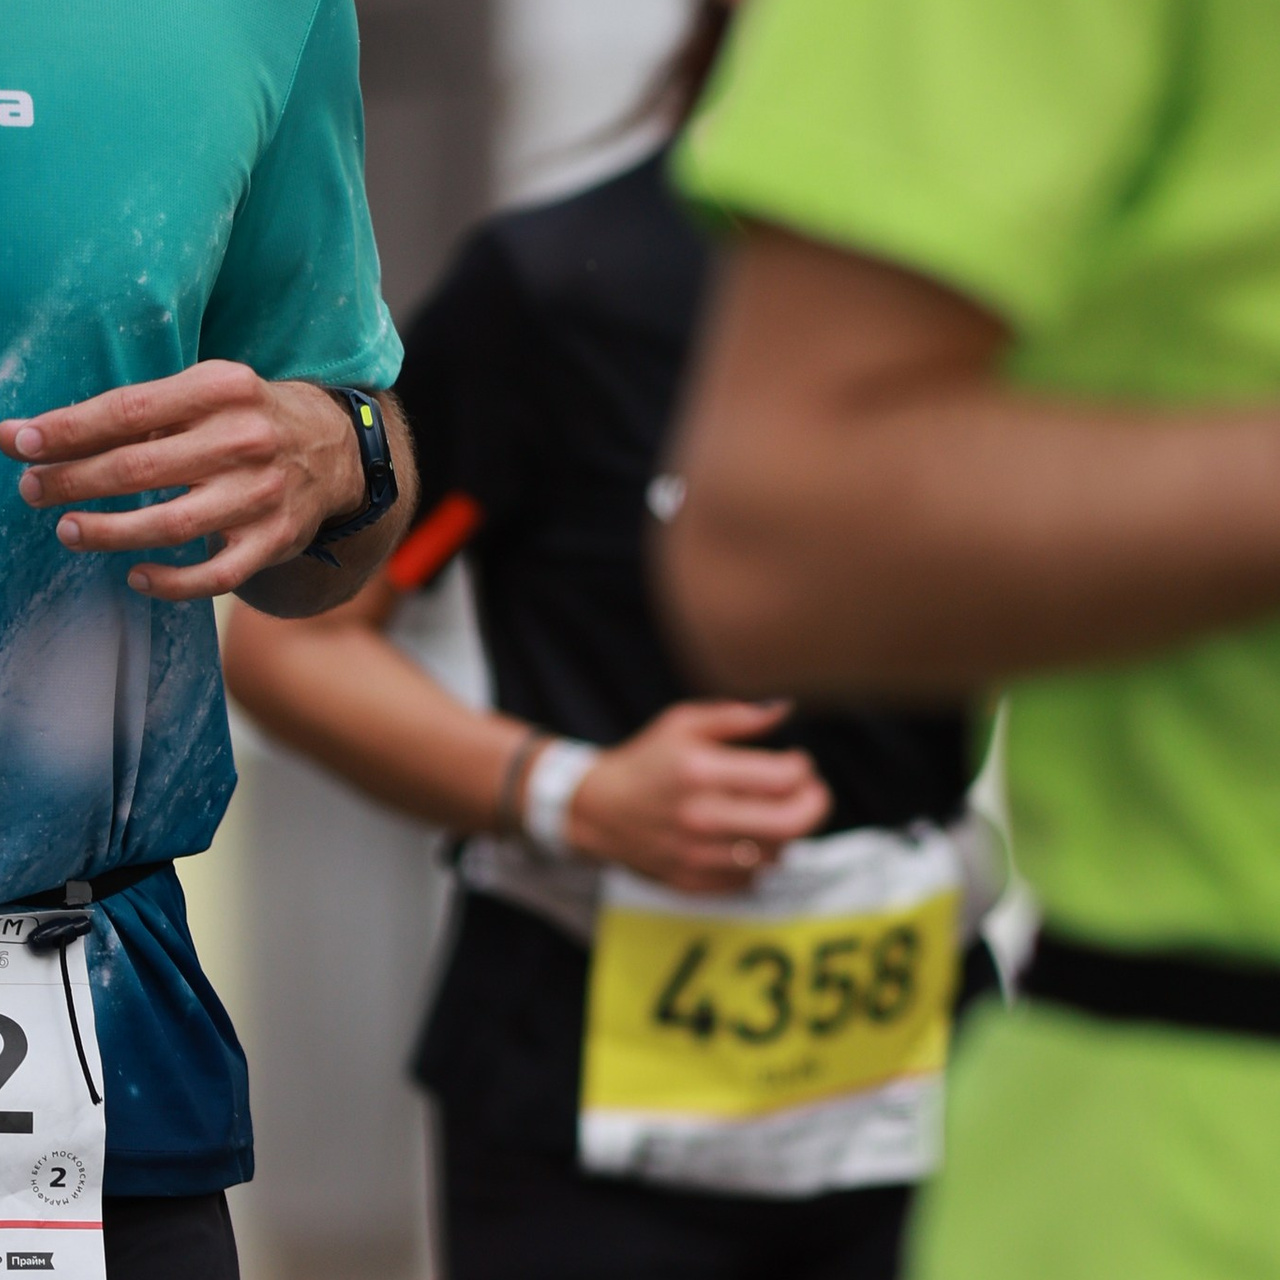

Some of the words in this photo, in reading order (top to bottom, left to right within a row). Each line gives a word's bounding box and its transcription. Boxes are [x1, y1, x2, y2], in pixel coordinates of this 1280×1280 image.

[652, 923, 921, 1046] 4358
[49, 1166, 67, 1188] 2
[11, 1256, 46, 1268] Прайм
